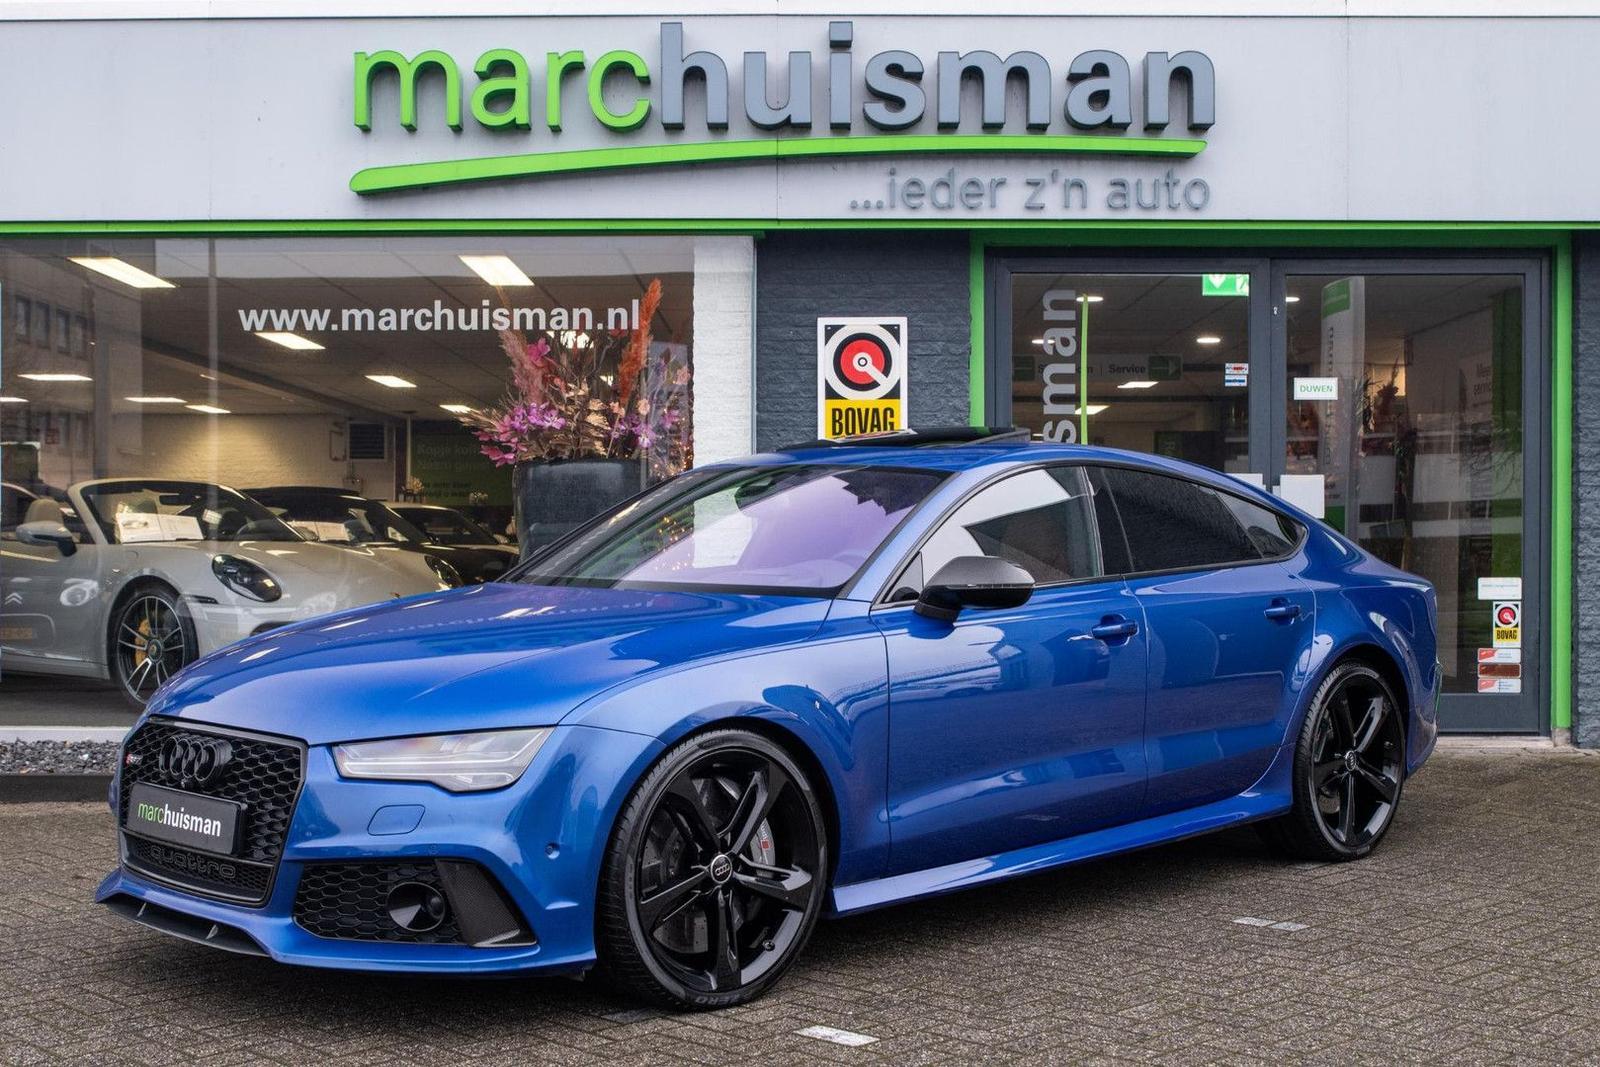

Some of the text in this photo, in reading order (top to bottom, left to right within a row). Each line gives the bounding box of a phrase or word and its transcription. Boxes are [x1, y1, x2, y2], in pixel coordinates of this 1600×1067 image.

[353, 21, 1216, 132] marchuisman
[850, 167, 1210, 210] ...ieder z'n auto
[238, 299, 640, 332] www.marchuisman.nl
[1299, 385, 1333, 393] DUWEN
[831, 407, 895, 436] BOVAG
[1496, 629, 1517, 640] BOVAG
[137, 803, 222, 837] marchuisman
[151, 846, 236, 879] quattro
